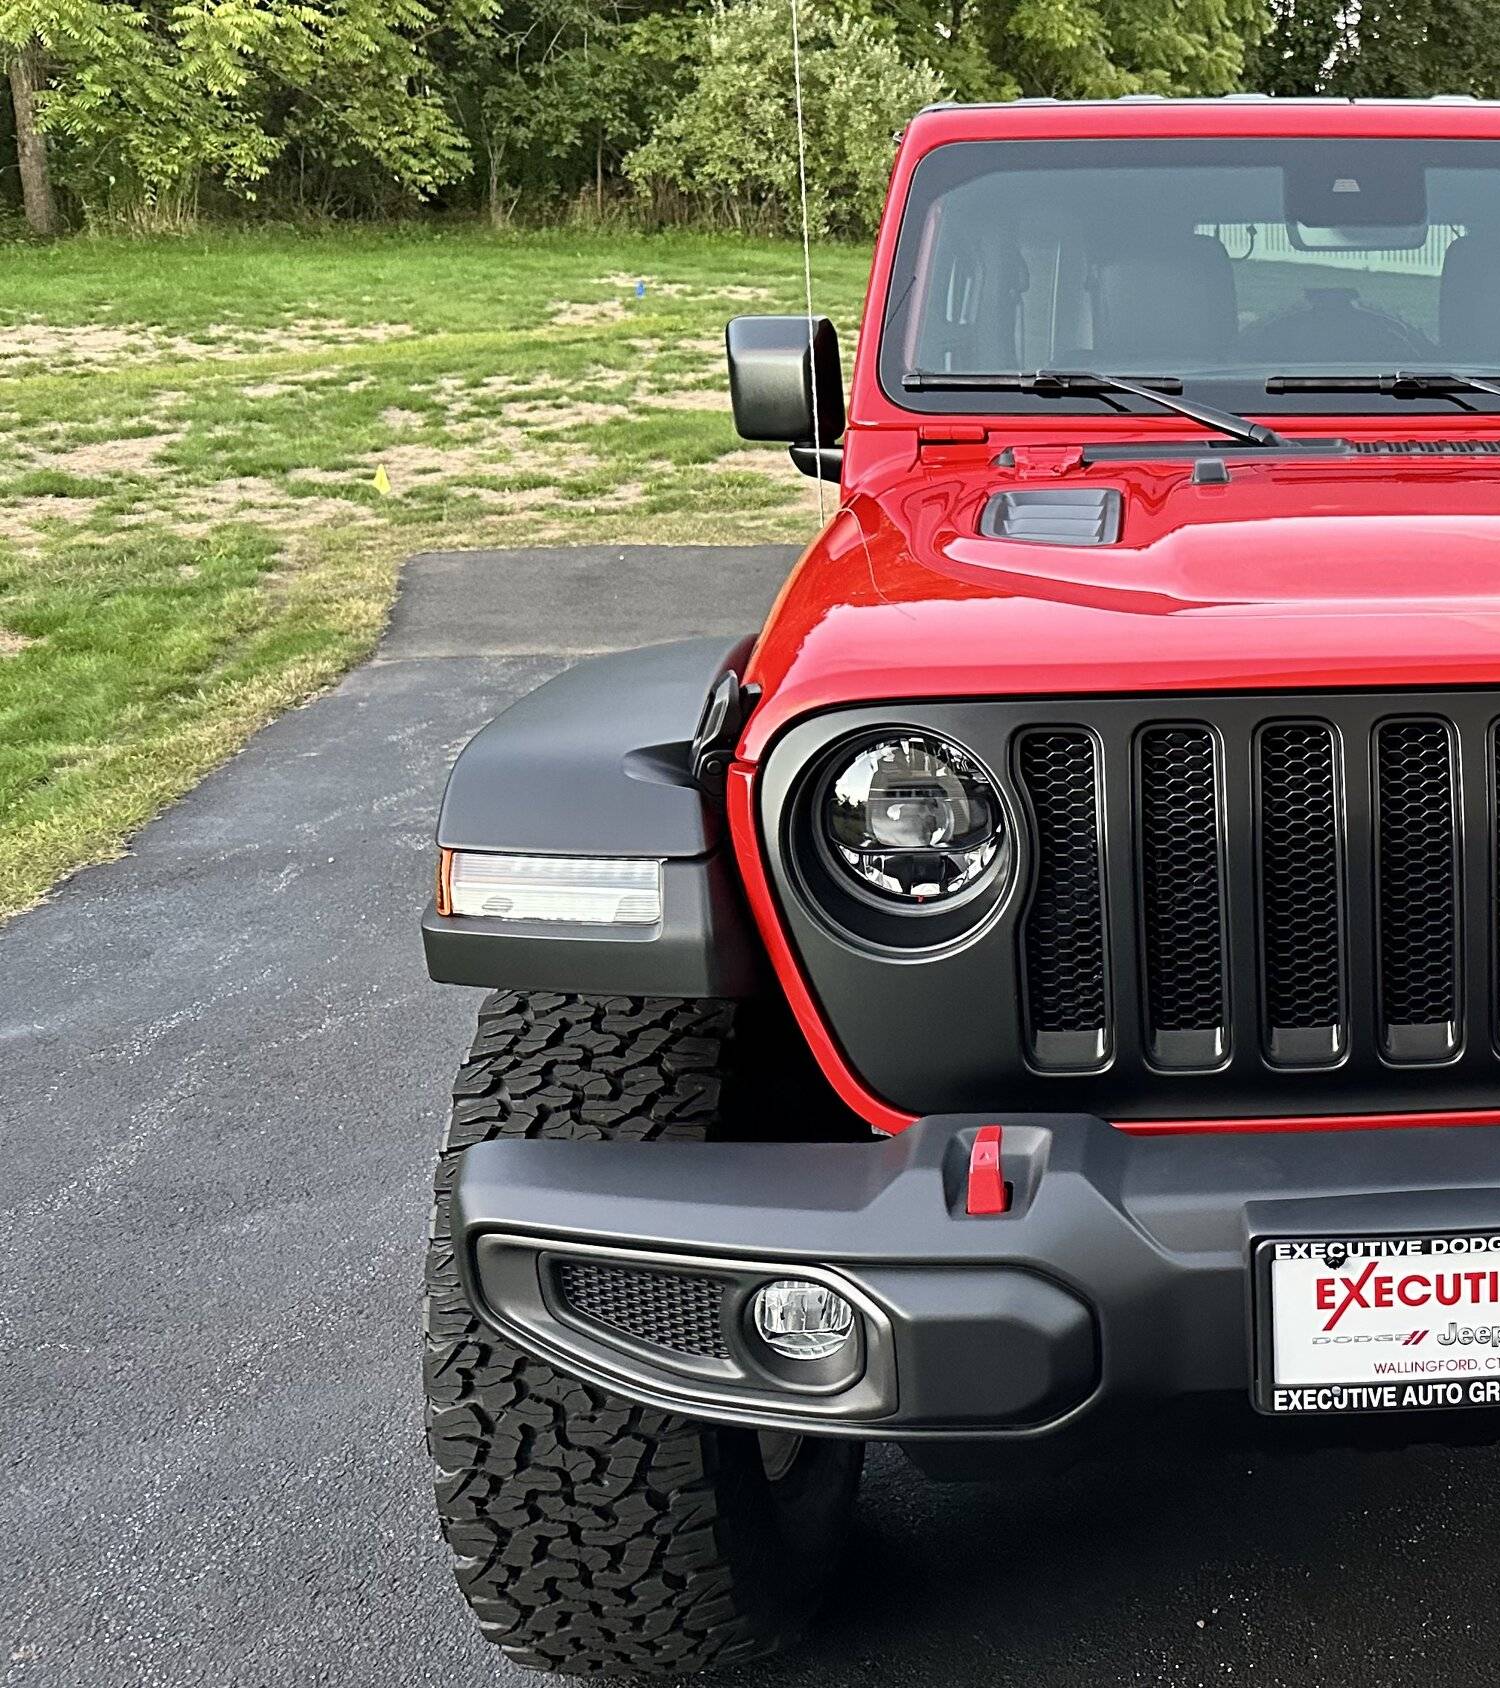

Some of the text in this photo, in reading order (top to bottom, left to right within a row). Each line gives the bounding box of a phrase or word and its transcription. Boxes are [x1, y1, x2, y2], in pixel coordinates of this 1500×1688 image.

[1275, 1240, 1422, 1260] EXECUTIVE
[1312, 1333, 1412, 1345] DODGE
[1374, 1358, 1482, 1374] WALLINGFORD,
[1274, 1386, 1397, 1411] EXECUTIVE
[1402, 1382, 1463, 1406] AUTO
